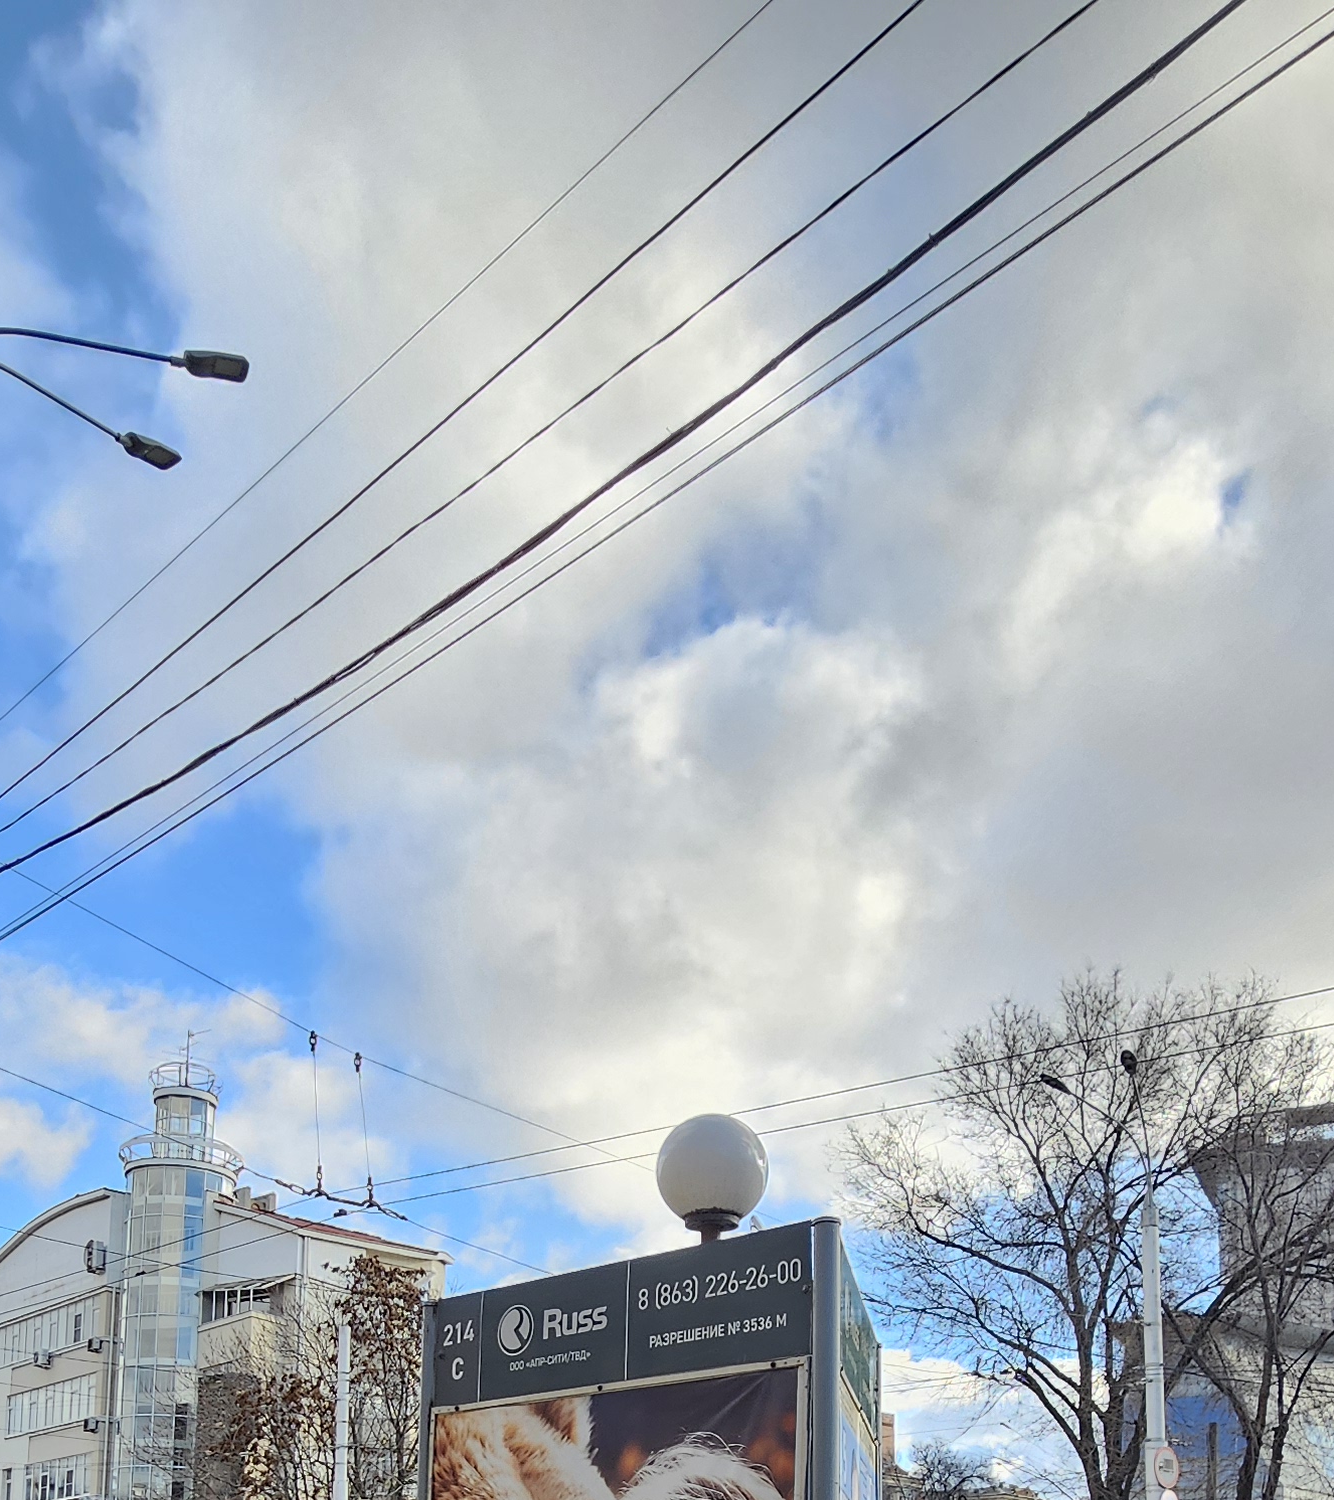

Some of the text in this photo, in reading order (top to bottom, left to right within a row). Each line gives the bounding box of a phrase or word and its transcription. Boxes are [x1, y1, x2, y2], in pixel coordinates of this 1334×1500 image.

[638, 1258, 802, 1310] 8 (863) 226-26-00
[443, 1319, 475, 1347] 214
[542, 1306, 608, 1340] Russ
[649, 1323, 725, 1348] РАЗРЕШЕНИЕ
[727, 1320, 741, 1336] №
[742, 1315, 773, 1333] 3536
[509, 1359, 524, 1372] ООО
